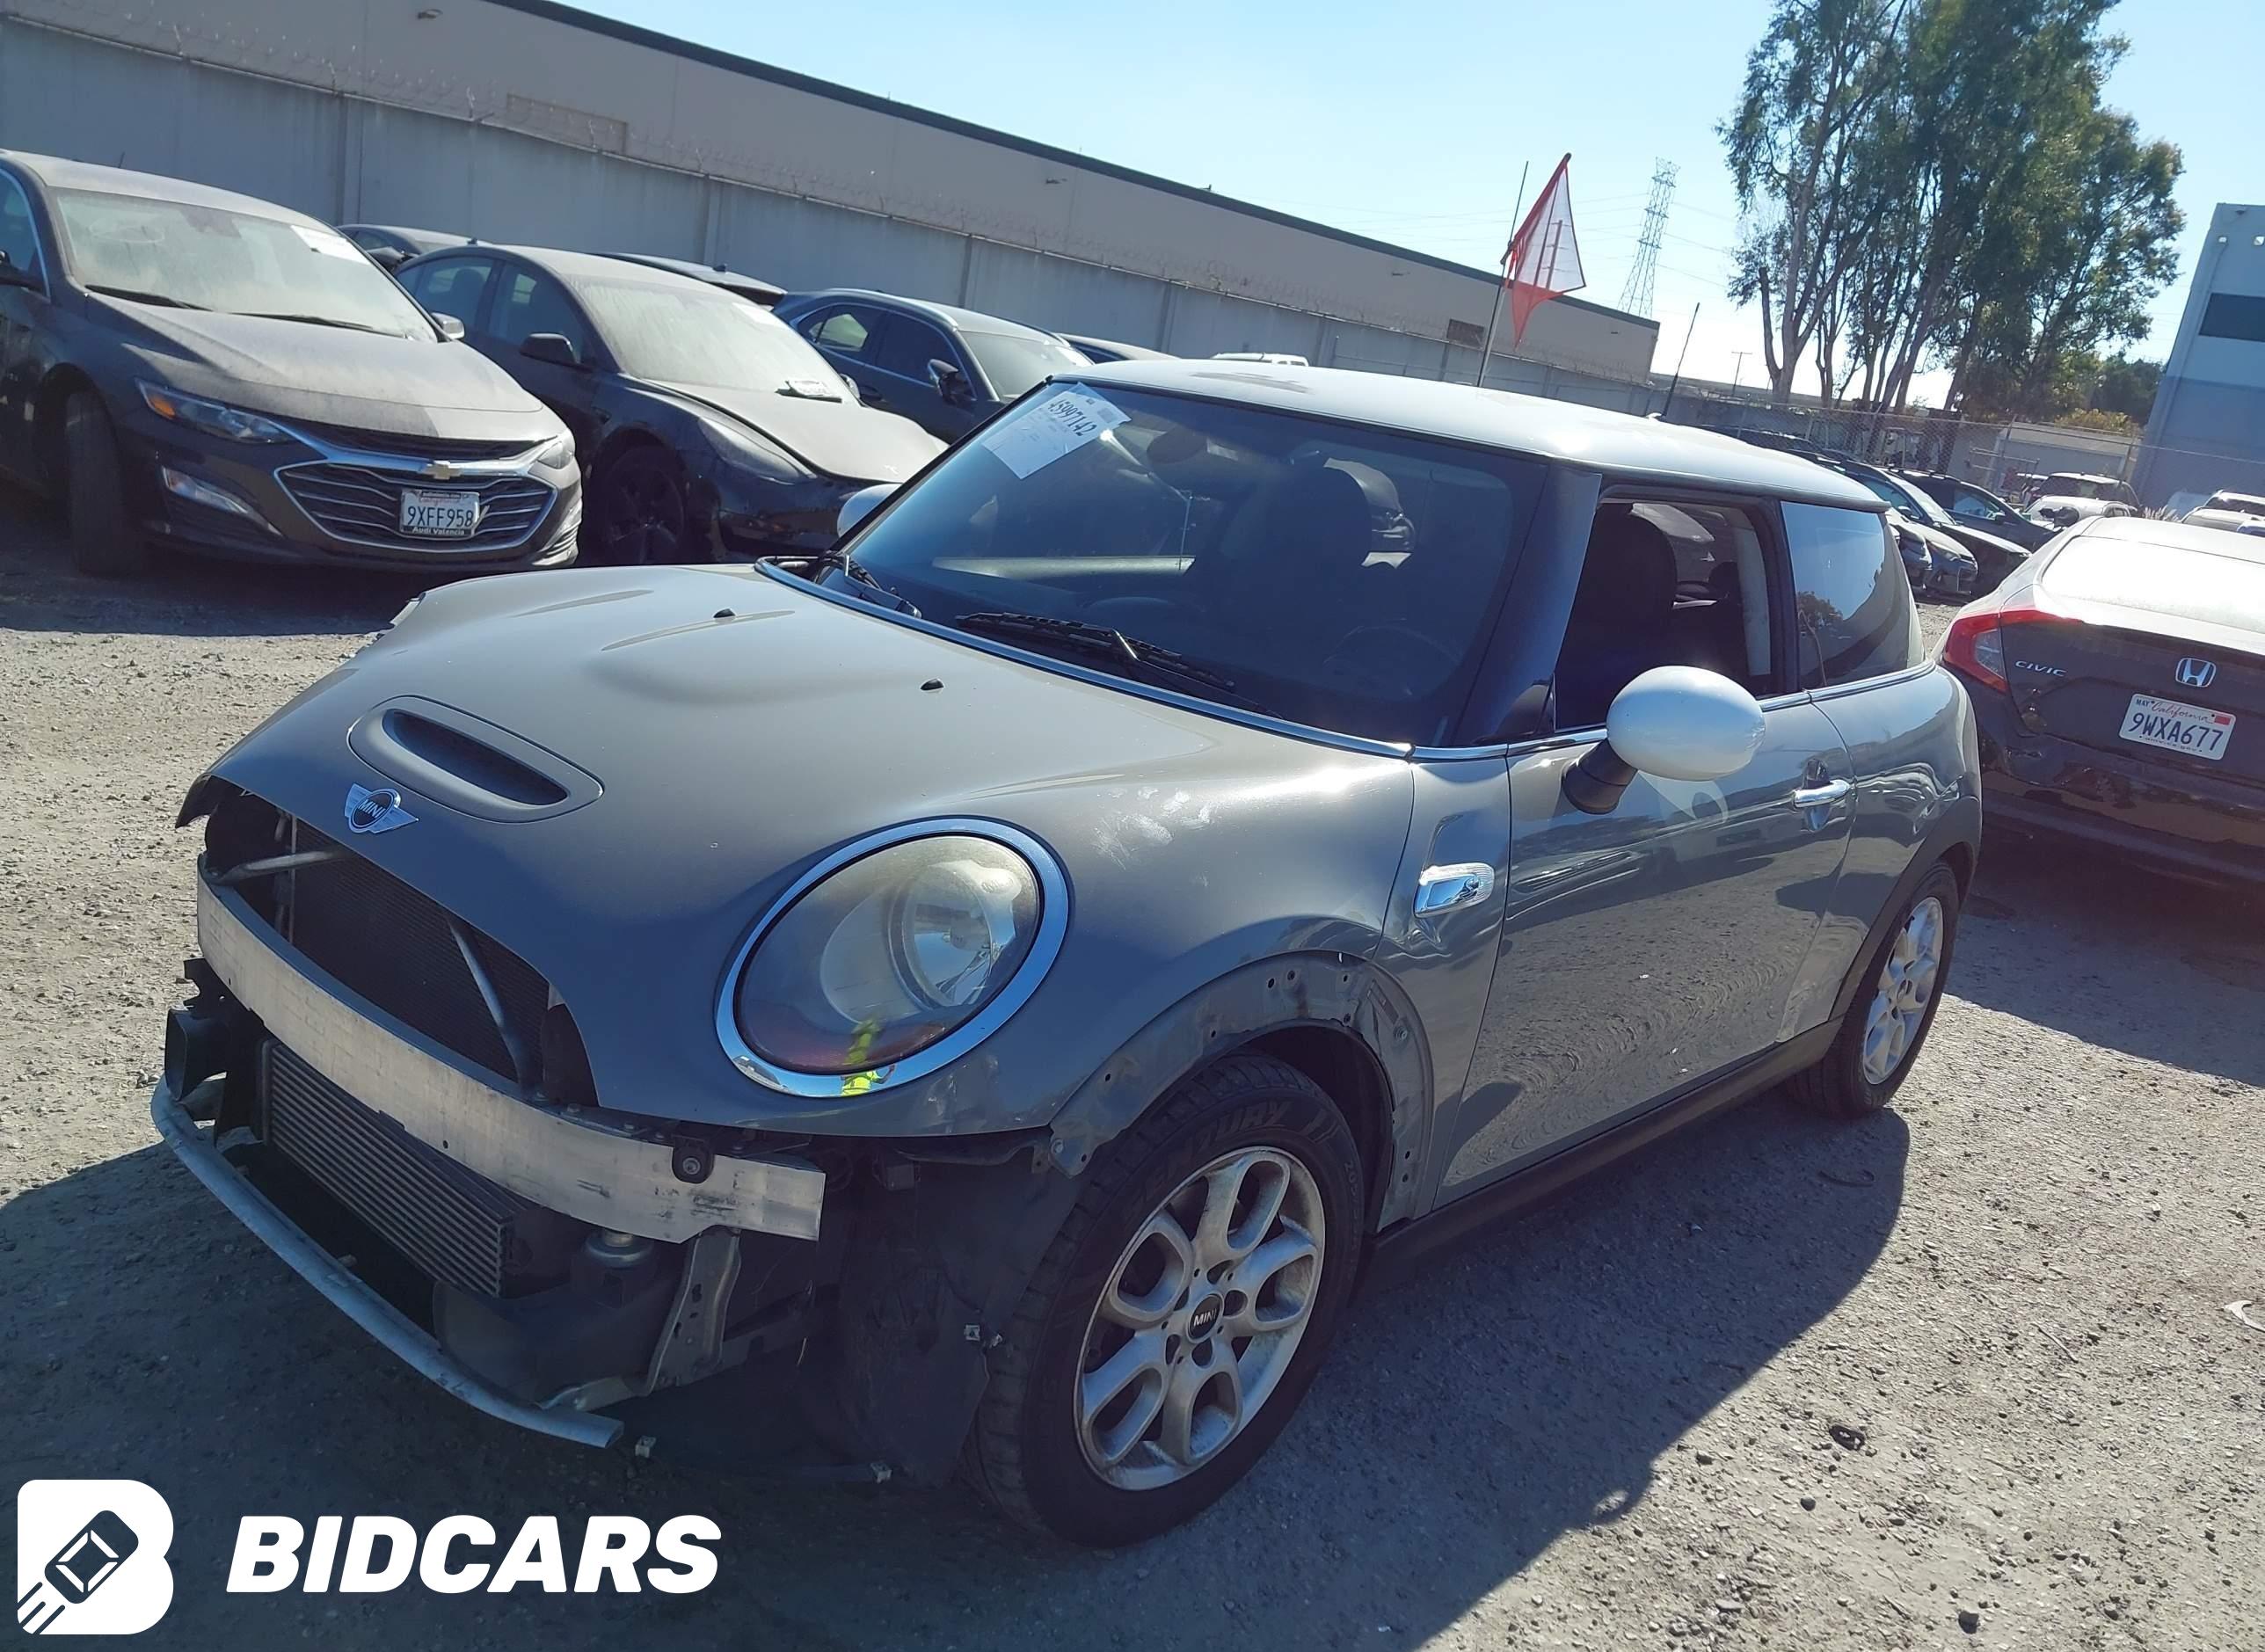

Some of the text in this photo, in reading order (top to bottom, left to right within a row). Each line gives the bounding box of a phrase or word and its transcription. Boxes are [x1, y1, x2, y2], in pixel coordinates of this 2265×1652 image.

[407, 506, 474, 527] 9XFF958
[2015, 660, 2067, 677] CIVIC
[2152, 702, 2214, 724] California
[2128, 712, 2224, 751] 9WXA677
[358, 798, 387, 819] MINI
[1193, 1308, 1217, 1327] MINI
